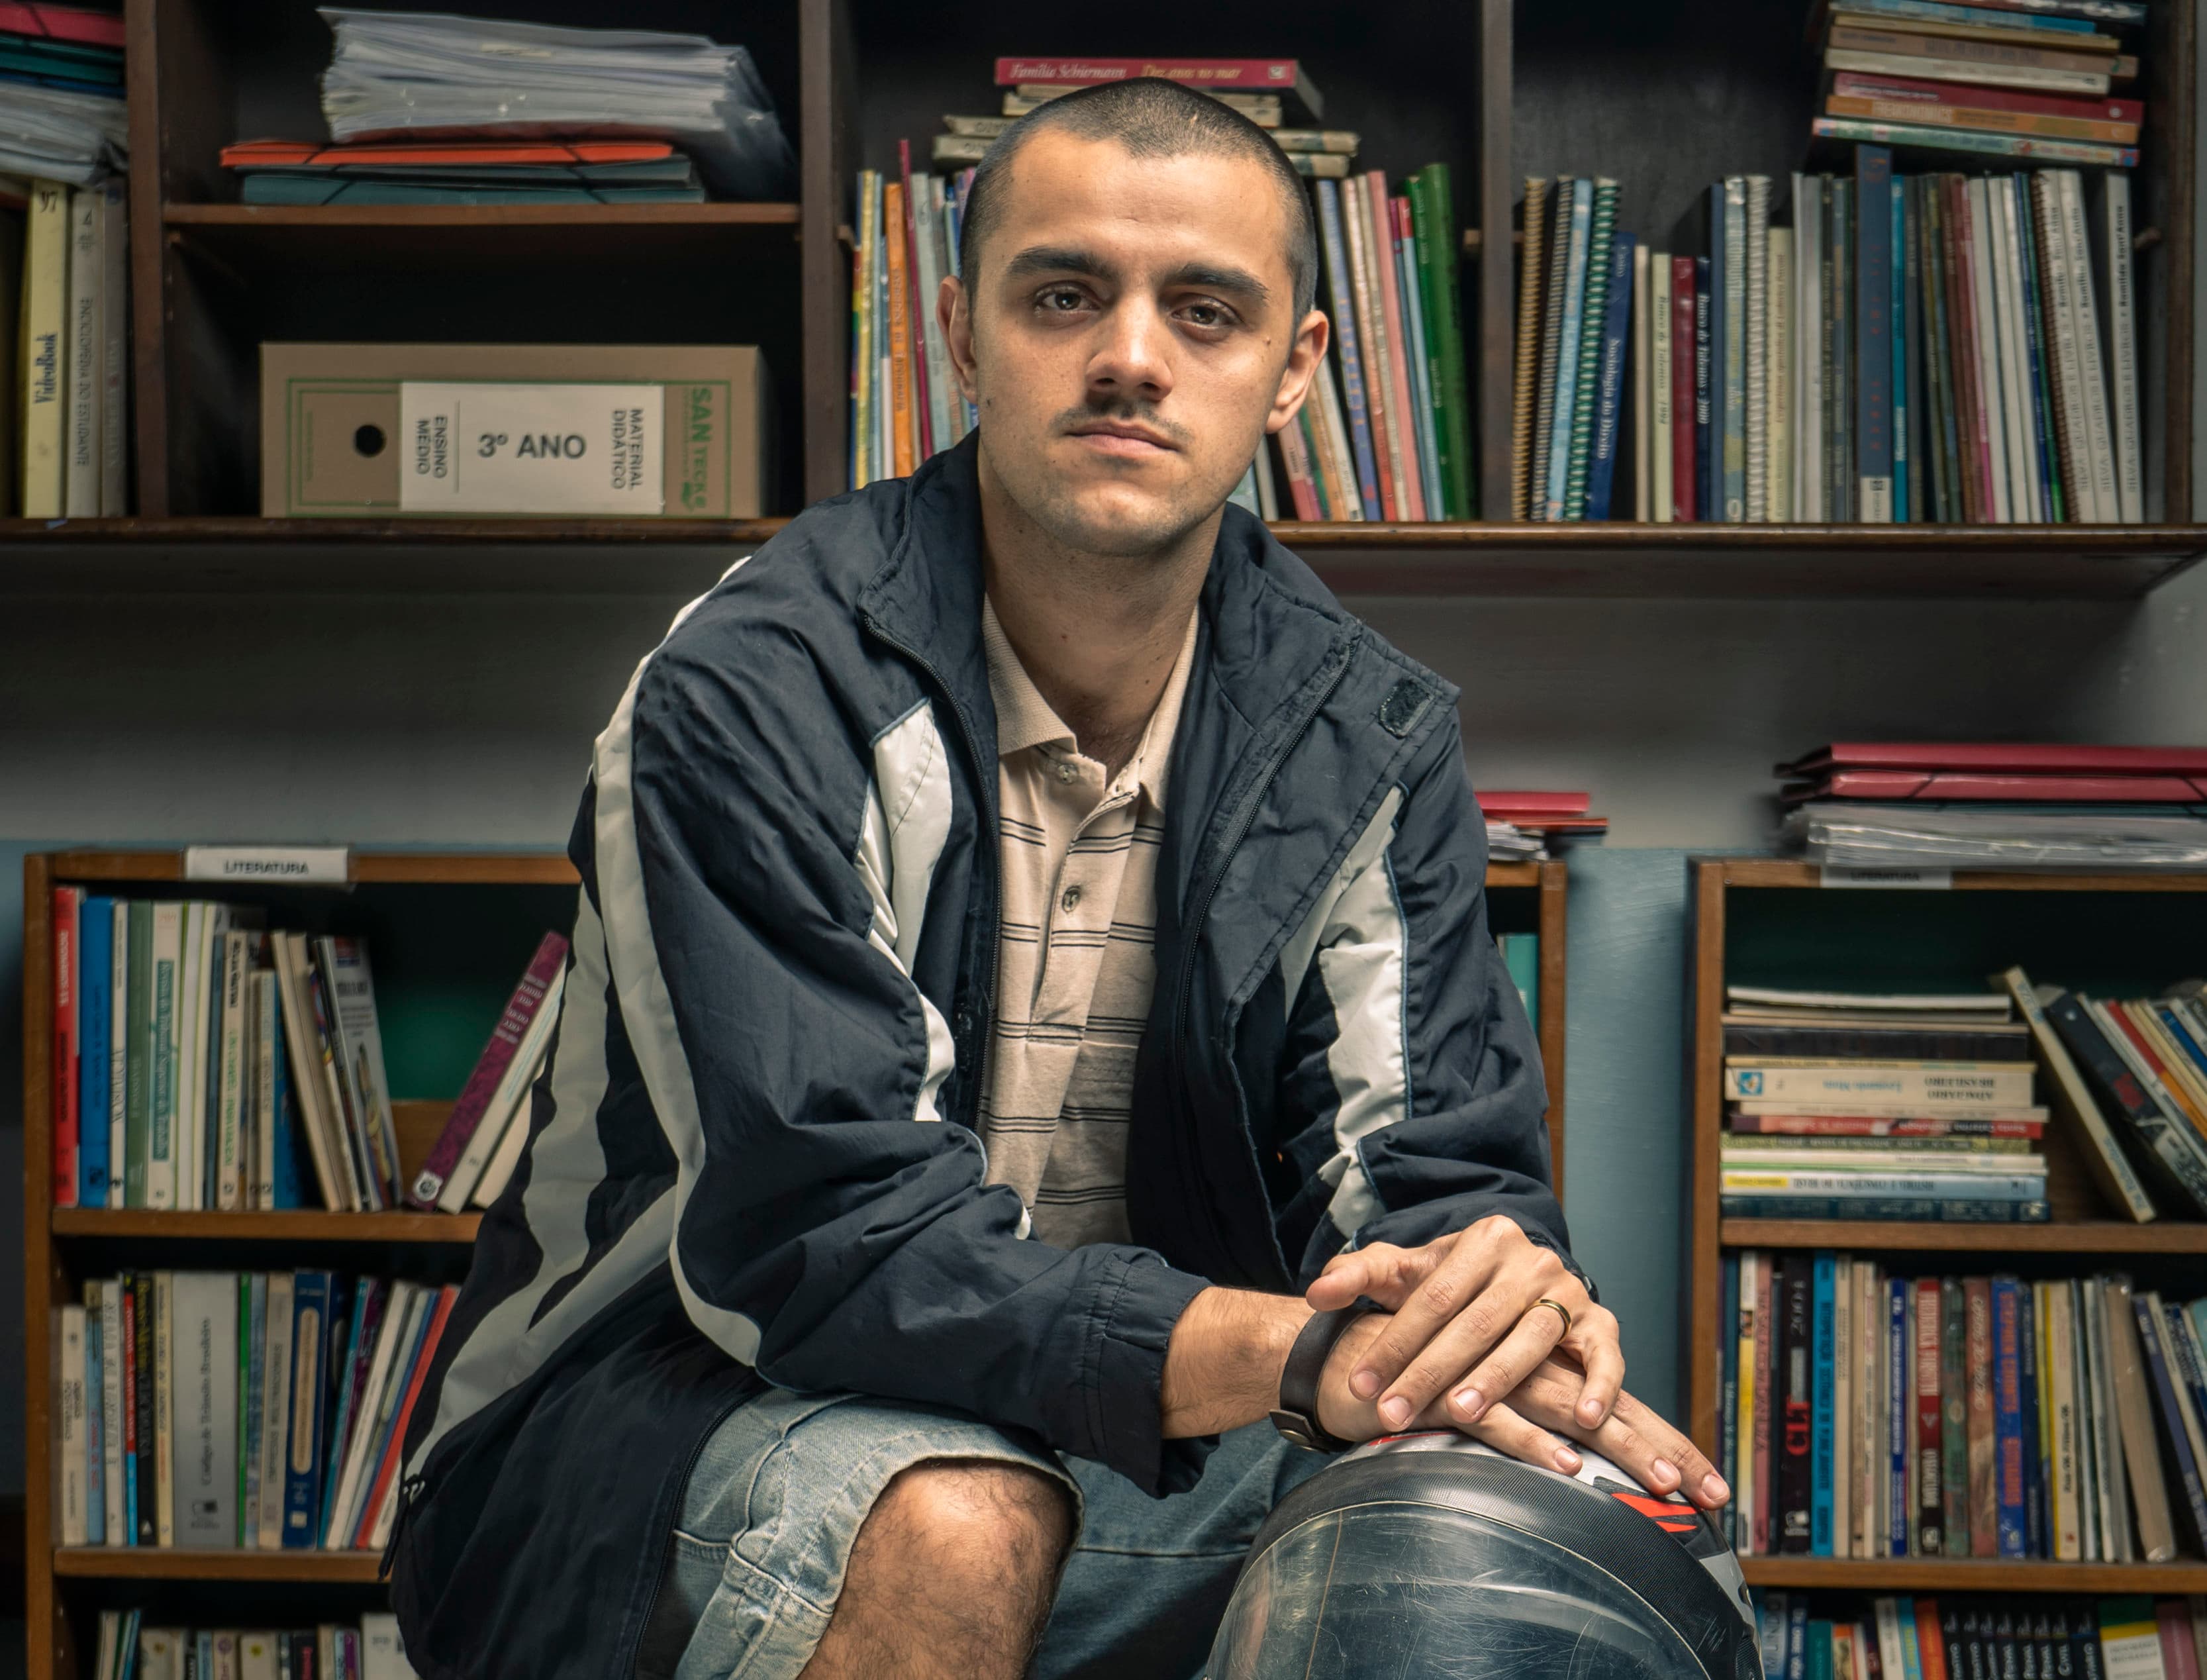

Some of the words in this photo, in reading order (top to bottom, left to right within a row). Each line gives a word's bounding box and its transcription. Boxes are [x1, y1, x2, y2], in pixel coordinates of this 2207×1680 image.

[1010, 62, 1055, 78] Família
[1056, 62, 1126, 78] Schürmann
[1140, 62, 1165, 77] Dez
[1166, 67, 1196, 78] anos
[1197, 67, 1214, 78] no
[1214, 67, 1243, 78] mar
[1697, 294, 1710, 327] Banco
[32, 331, 58, 405] VideoBook
[1602, 337, 1622, 399] Sociologia
[2119, 322, 2132, 371] LIVROS
[691, 387, 713, 442] SAN
[1602, 399, 1615, 417] do
[75, 403, 91, 468] ESTUDANTE
[415, 418, 431, 475] MÉDIO
[432, 415, 448, 479] ENSINO
[477, 432, 509, 459] 3º
[516, 433, 587, 460] ANO
[611, 409, 627, 490] DIDÁTICO
[628, 408, 644, 491] MATERIAL
[1596, 417, 1614, 461] Direito
[224, 861, 309, 874] LITERATURA
[160, 963, 171, 998] Revista
[160, 999, 170, 1012] do
[159, 1014, 170, 1052] Tribunal
[156, 1054, 170, 1096] Superior
[1924, 1076, 1996, 1087] BRASILEIRO
[158, 1099, 168, 1112] do
[156, 1115, 168, 1159] Trabalho
[199, 1316, 211, 1375] Brasileiro
[200, 1377, 211, 1424] Trânsito
[201, 1426, 211, 1442] de
[1786, 1397, 1810, 1456] CLT
